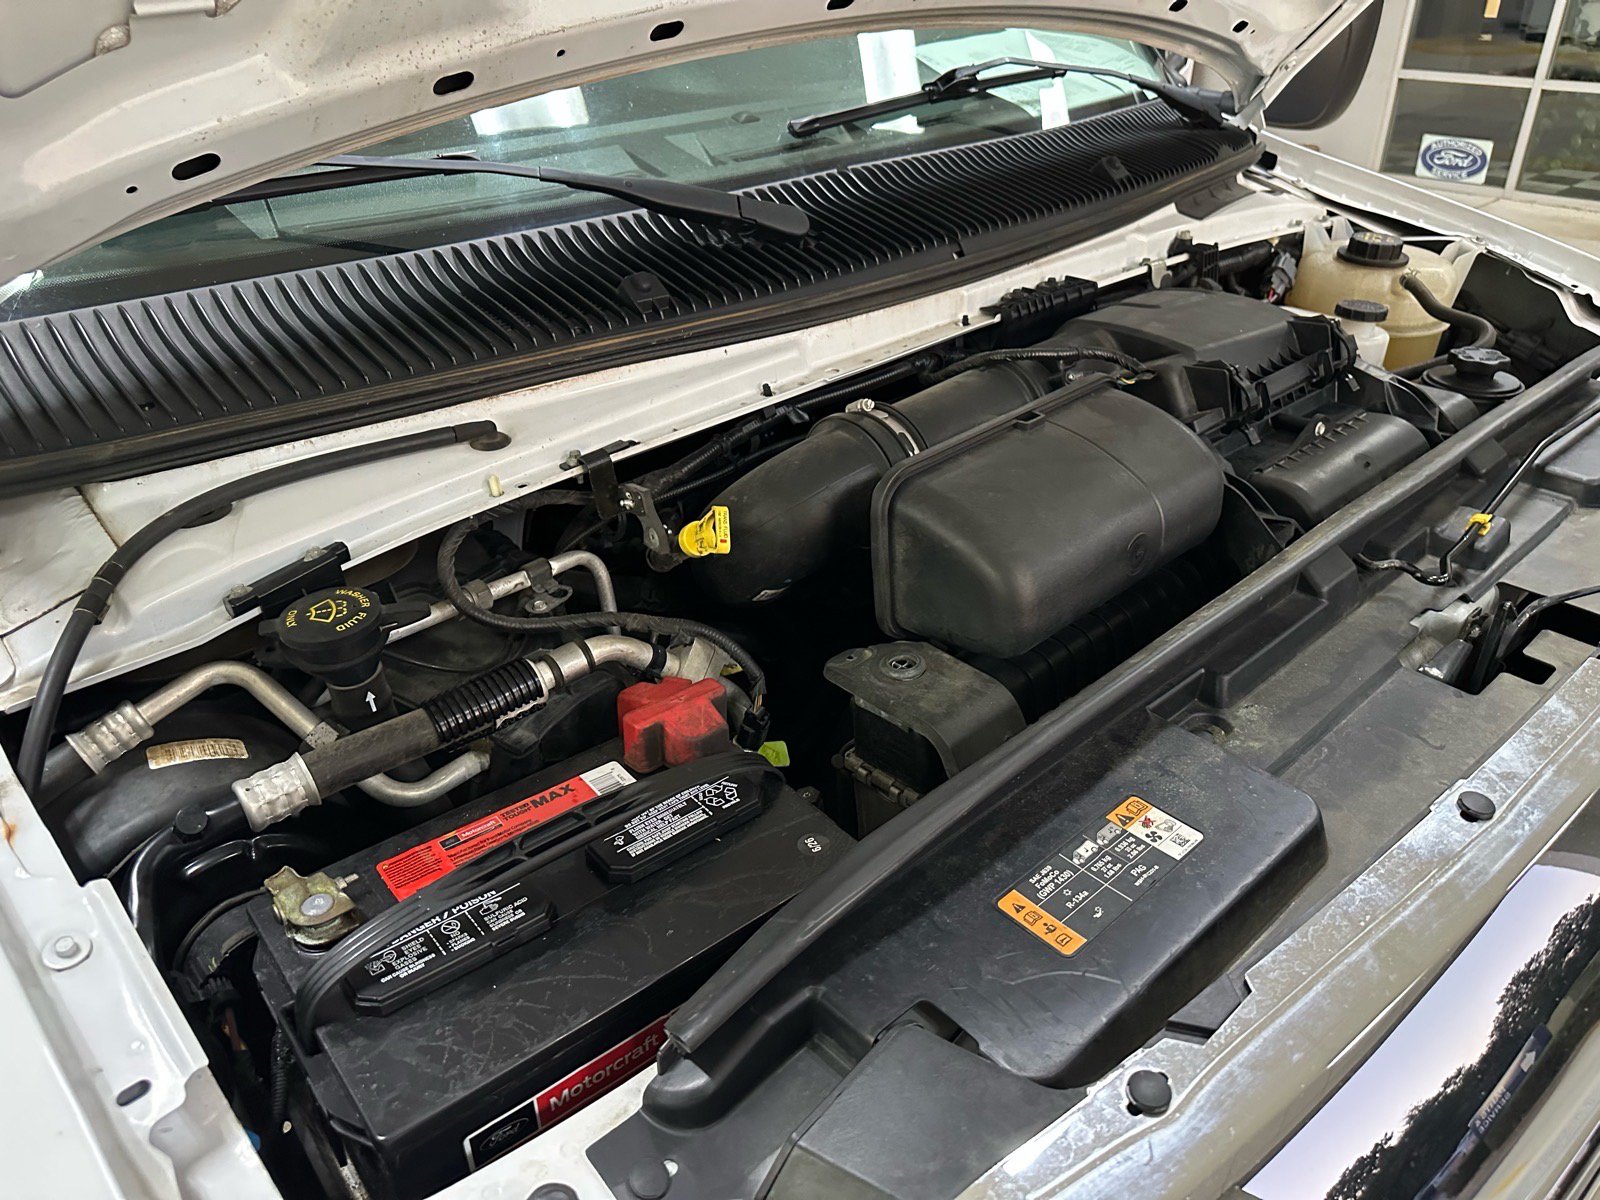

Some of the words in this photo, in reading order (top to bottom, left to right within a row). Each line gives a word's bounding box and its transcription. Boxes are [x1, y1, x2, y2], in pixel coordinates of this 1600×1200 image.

[1433, 150, 1474, 167] Ford
[336, 589, 370, 608] WASHER
[286, 610, 298, 628] ONLY
[336, 611, 368, 632] FLUID
[530, 782, 574, 809] MAX
[500, 802, 529, 818] TESTED
[461, 818, 495, 838] Motorcraft
[1125, 835, 1135, 844] kg
[1101, 854, 1112, 863] kg
[1028, 872, 1041, 884] SAE
[1034, 868, 1060, 889] FoMoCo
[1129, 863, 1147, 877] PAG
[1036, 881, 1057, 900] (GWP
[1053, 868, 1074, 886] 1430)
[1064, 888, 1089, 909] R-134a
[483, 903, 513, 921] SULFURIC
[512, 896, 528, 907] ACID
[448, 931, 468, 943] SPARKS
[450, 930, 460, 938] NO
[400, 936, 425, 951] SHIELD
[404, 943, 421, 955] EYES
[391, 945, 427, 966] EXPLOSIVE
[394, 956, 417, 970] GASES
[380, 974, 392, 983] CAN
[391, 965, 409, 977] CAUSE
[550, 1033, 659, 1112] Motorcraft
